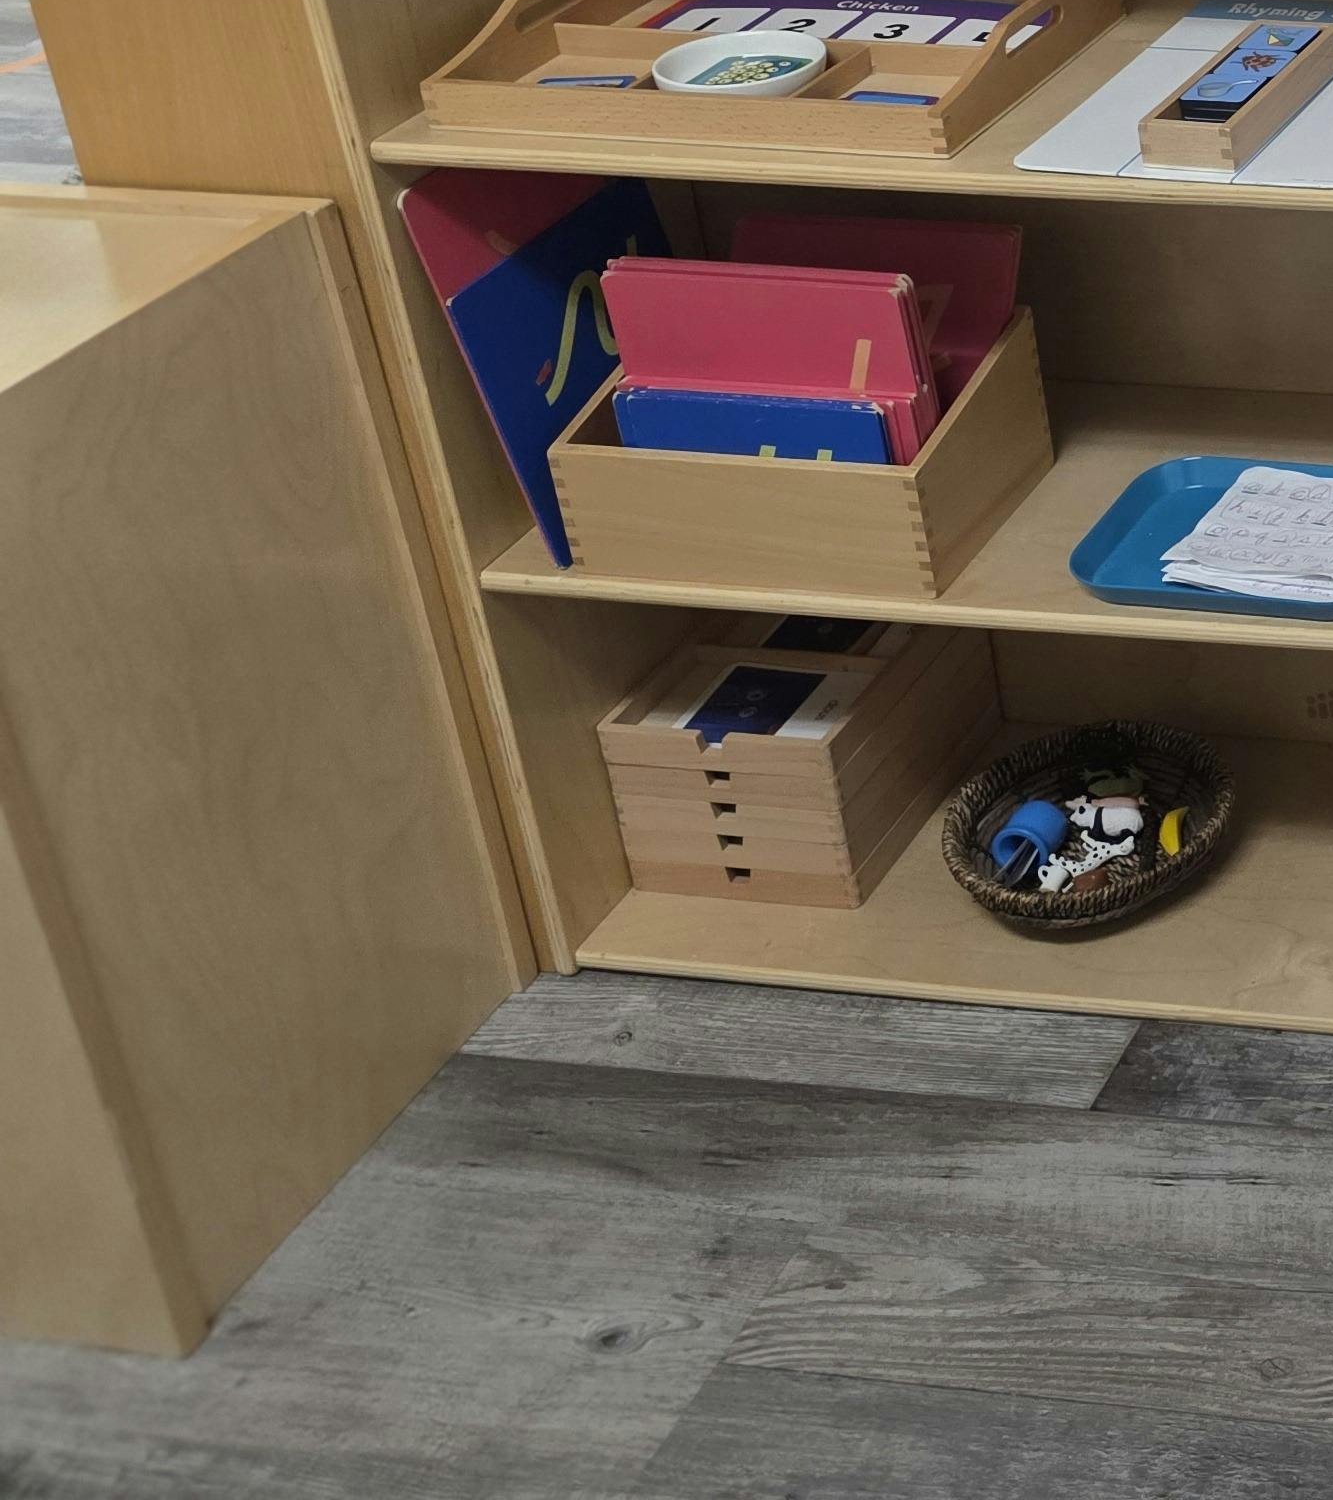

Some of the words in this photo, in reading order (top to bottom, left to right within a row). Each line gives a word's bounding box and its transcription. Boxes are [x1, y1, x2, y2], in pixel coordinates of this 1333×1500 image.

[836, 0, 921, 13] Chicken
[1227, 2, 1326, 21] Rhyming
[693, 16, 722, 32] 1
[780, 18, 817, 34] 2
[872, 23, 911, 40] 3
